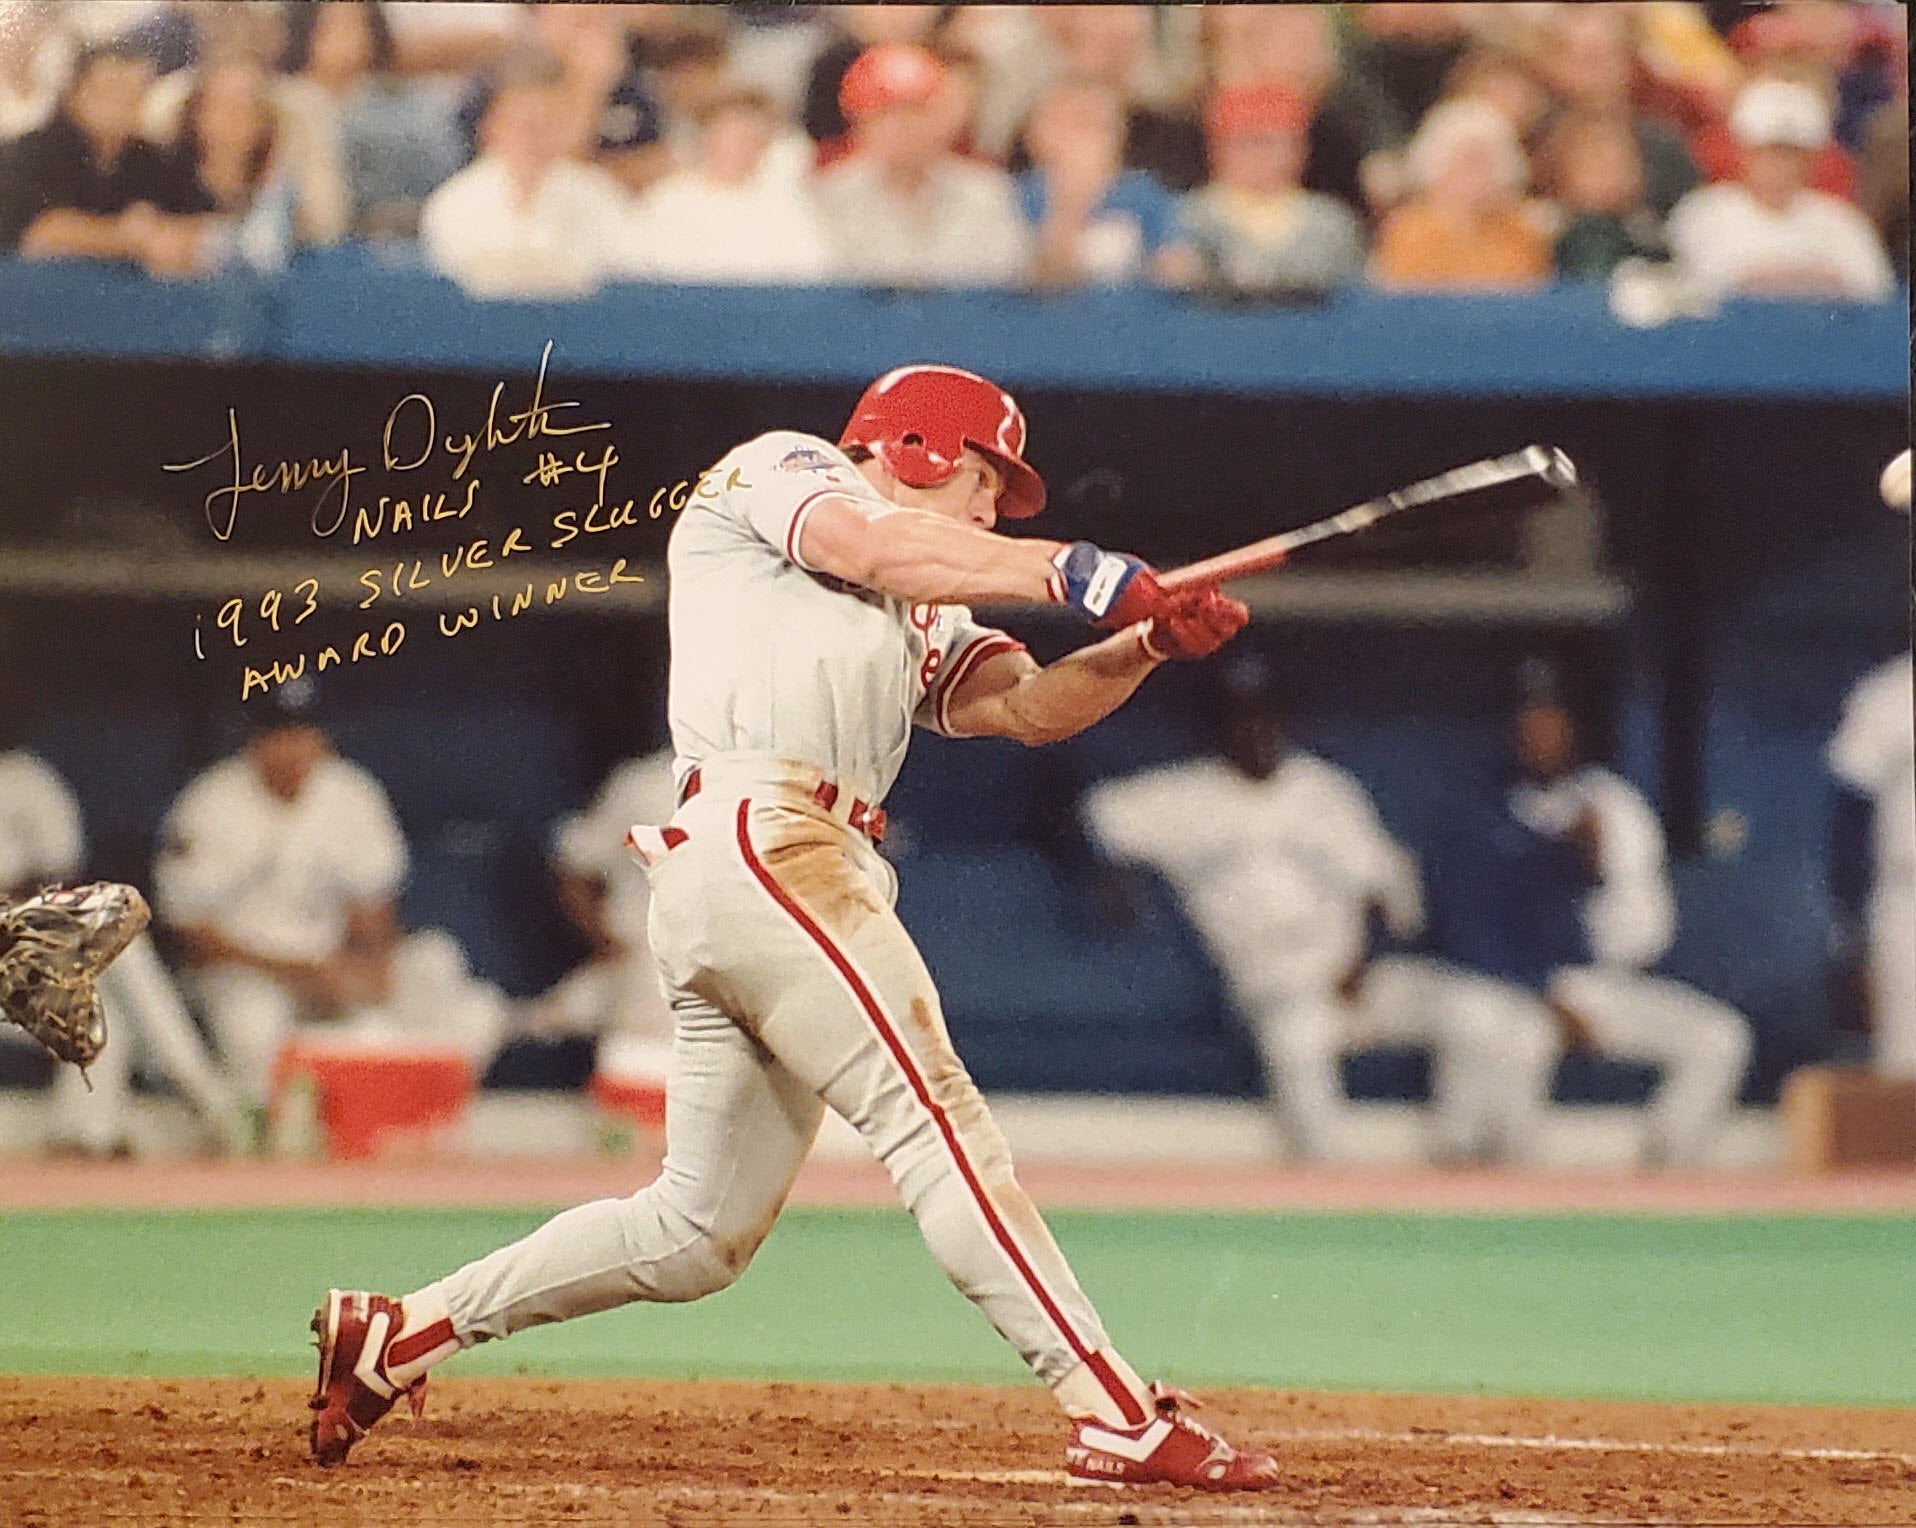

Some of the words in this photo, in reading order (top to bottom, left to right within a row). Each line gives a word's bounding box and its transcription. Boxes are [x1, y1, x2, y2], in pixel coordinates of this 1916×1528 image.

[194, 578, 319, 660] 1993
[358, 529, 531, 611] SILVER
[551, 464, 752, 548] SLUGGER
[353, 480, 481, 545] NAILS
[523, 445, 620, 506] #4
[240, 623, 405, 701] AWARD
[439, 559, 644, 637] WINNER
